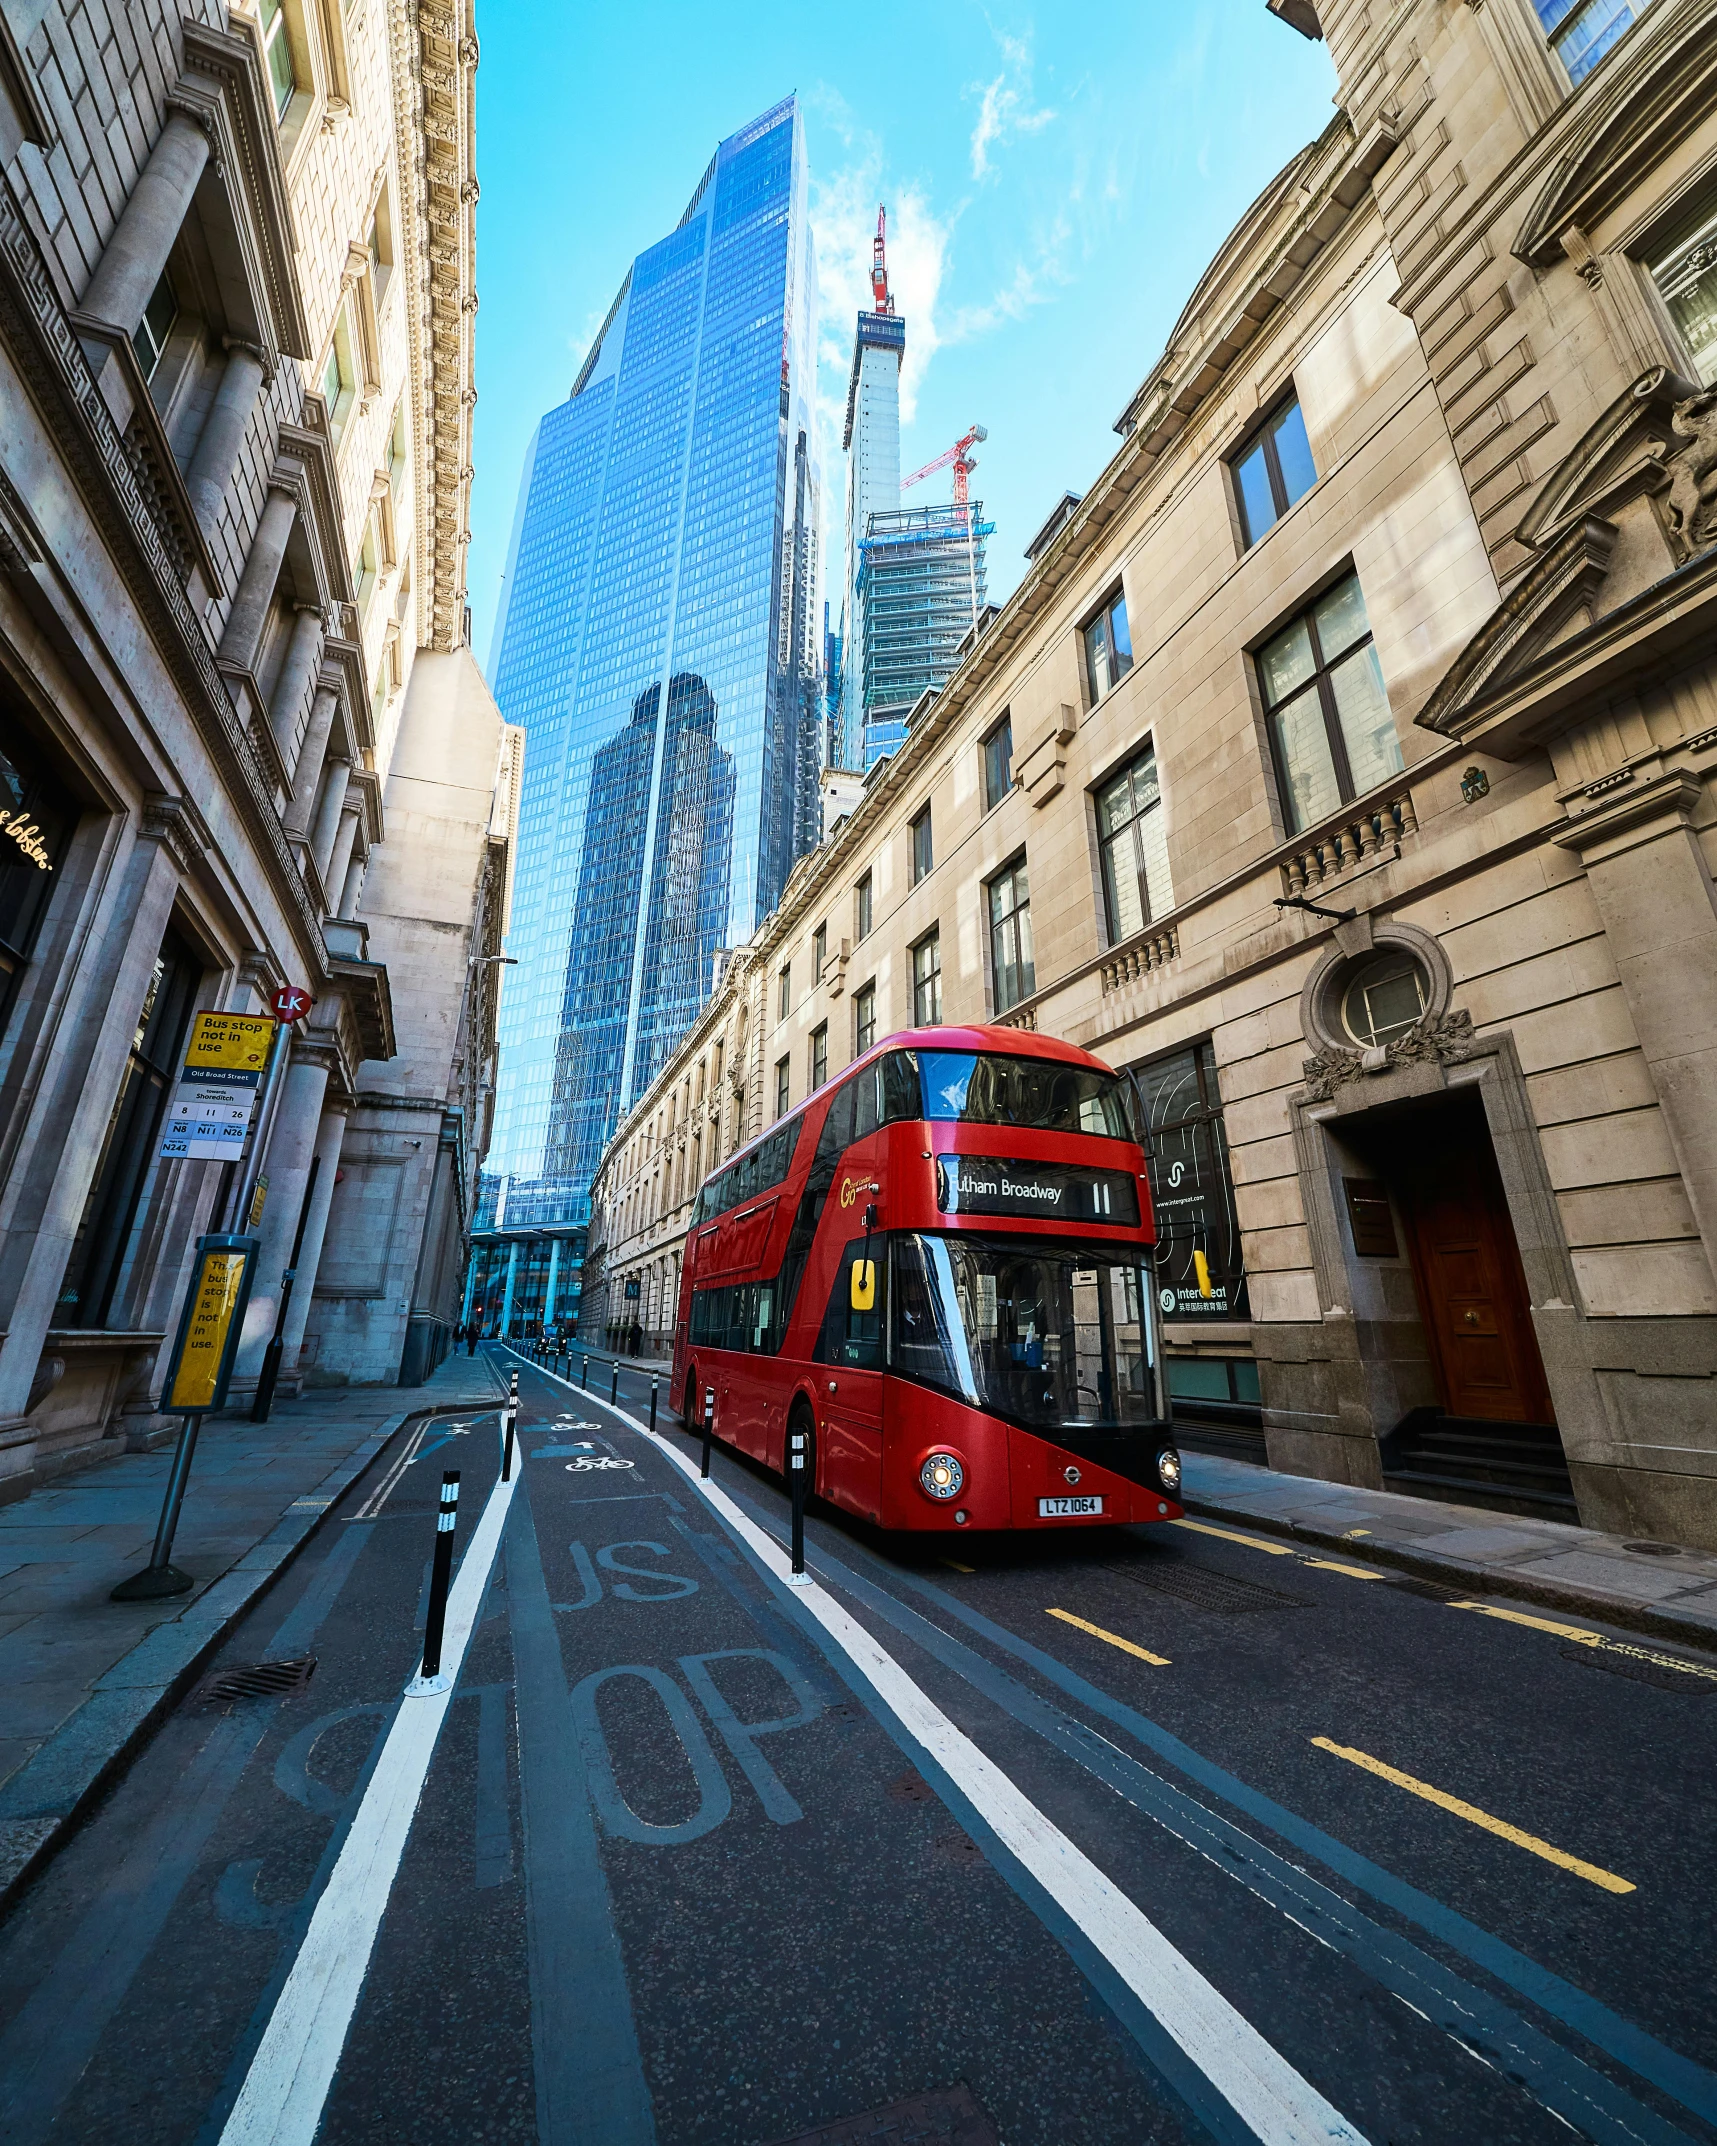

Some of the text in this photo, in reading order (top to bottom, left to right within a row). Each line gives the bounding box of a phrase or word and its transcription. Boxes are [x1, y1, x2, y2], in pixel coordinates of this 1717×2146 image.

[277, 994, 304, 1011] LK
[204, 1018, 263, 1034] Bus stop
[201, 1031, 241, 1042] not in
[198, 1043, 222, 1052] use
[205, 1071, 226, 1079] Broad
[196, 1093, 234, 1101] Shoreditch
[173, 1125, 187, 1133] N8
[197, 1127, 216, 1135] N11
[223, 1128, 243, 1137] N26
[162, 1143, 187, 1152] N242
[949, 1175, 1062, 1204] Fulham Broadway
[1092, 1182, 1111, 1214] 11
[1156, 1194, 1205, 1208] www.intergreat.com
[212, 1261, 234, 1270] This
[208, 1274, 228, 1283] bus
[204, 1287, 230, 1298] stop
[627, 1284, 638, 1296] M
[1177, 1286, 1227, 1300] Intereat
[201, 1300, 211, 1309] is
[198, 1314, 218, 1322] not
[194, 1326, 206, 1335] in
[191, 1341, 214, 1349] use.
